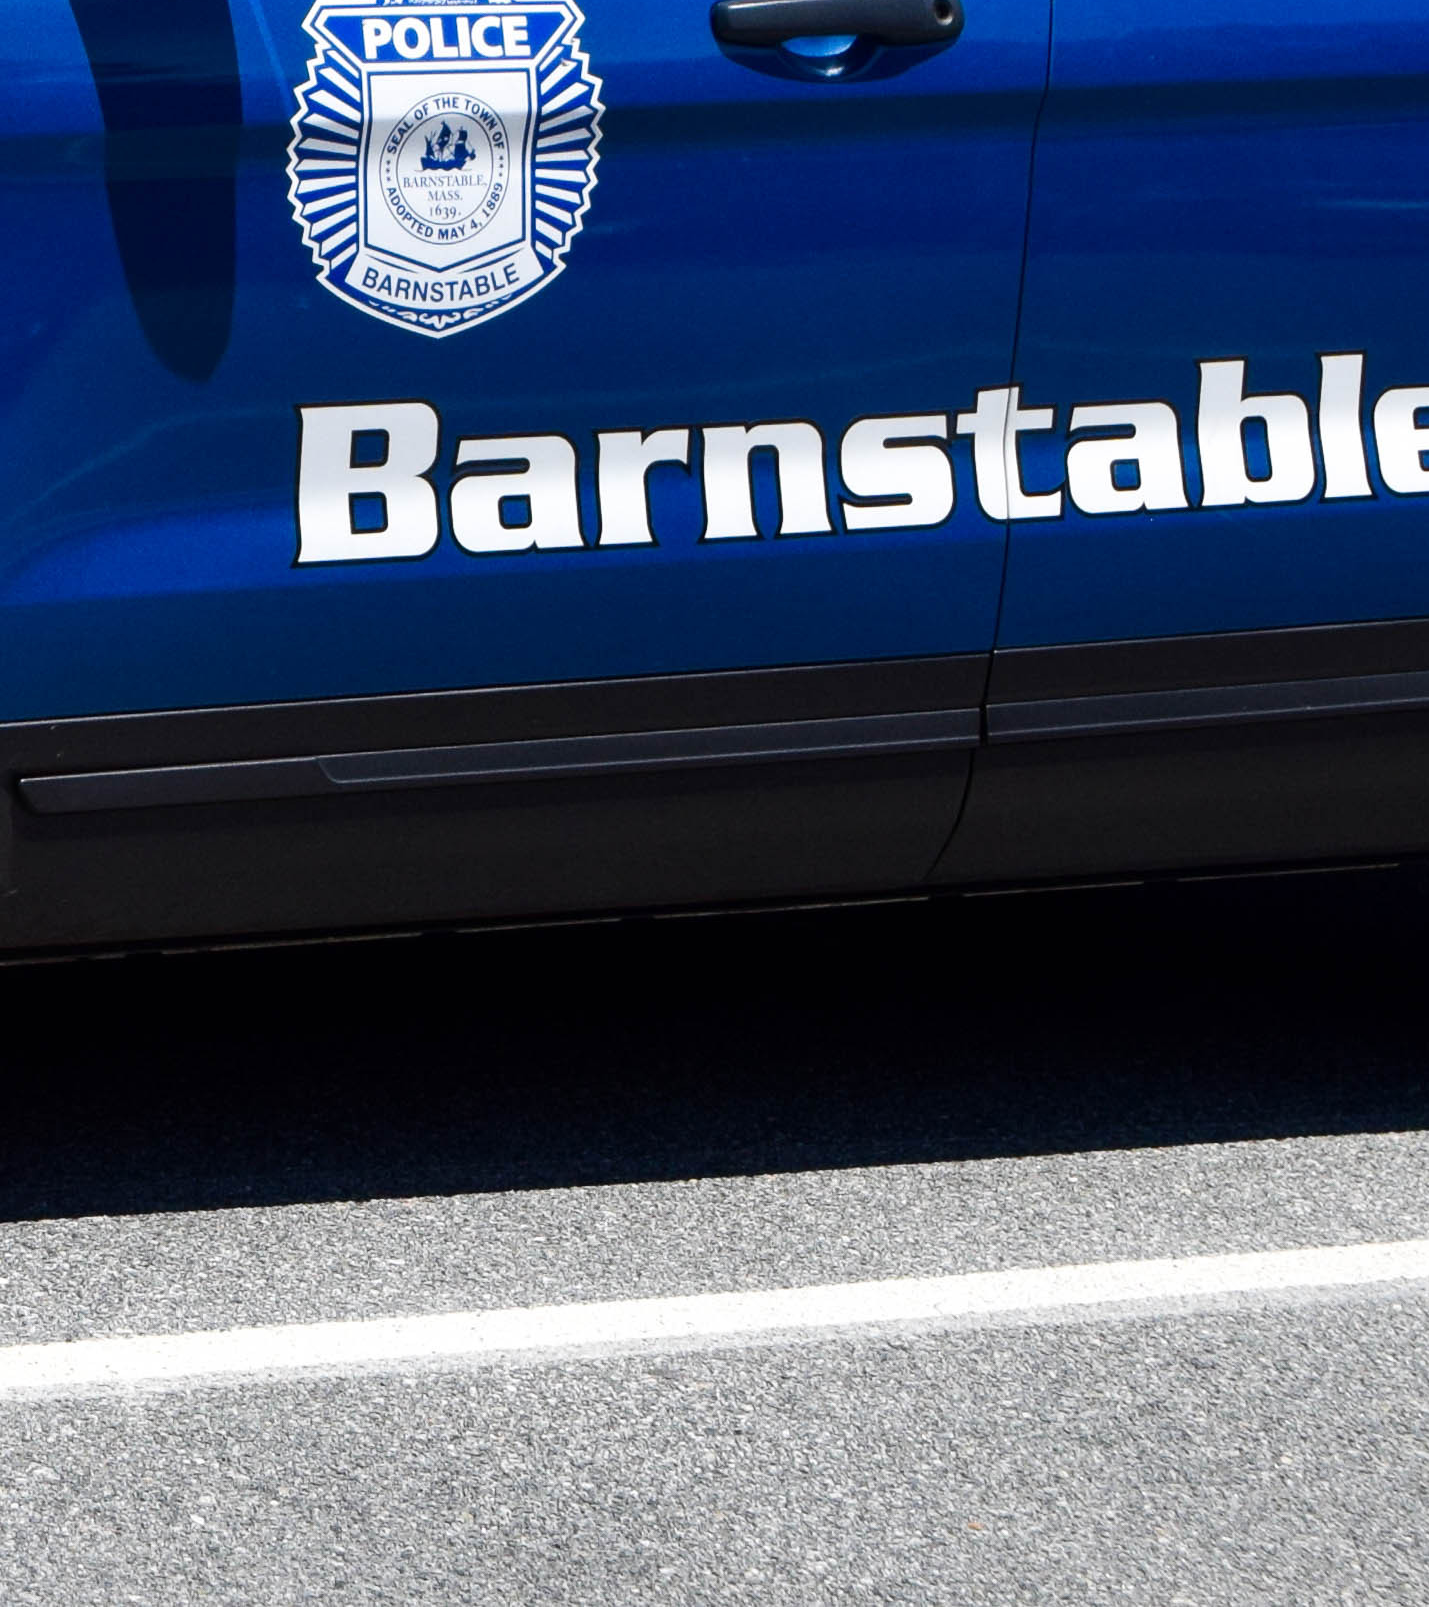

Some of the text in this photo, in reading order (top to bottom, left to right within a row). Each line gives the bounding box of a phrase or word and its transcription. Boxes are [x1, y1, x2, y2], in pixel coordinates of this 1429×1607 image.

[362, 15, 532, 60] POLICE
[387, 96, 505, 155] SEAL OF THE TOWN OF
[386, 182, 504, 241] ADOPTED MAY 4, 1889
[427, 190, 463, 202] MASS.
[429, 204, 462, 220] 1639.
[362, 262, 520, 303] BARNSTABLE
